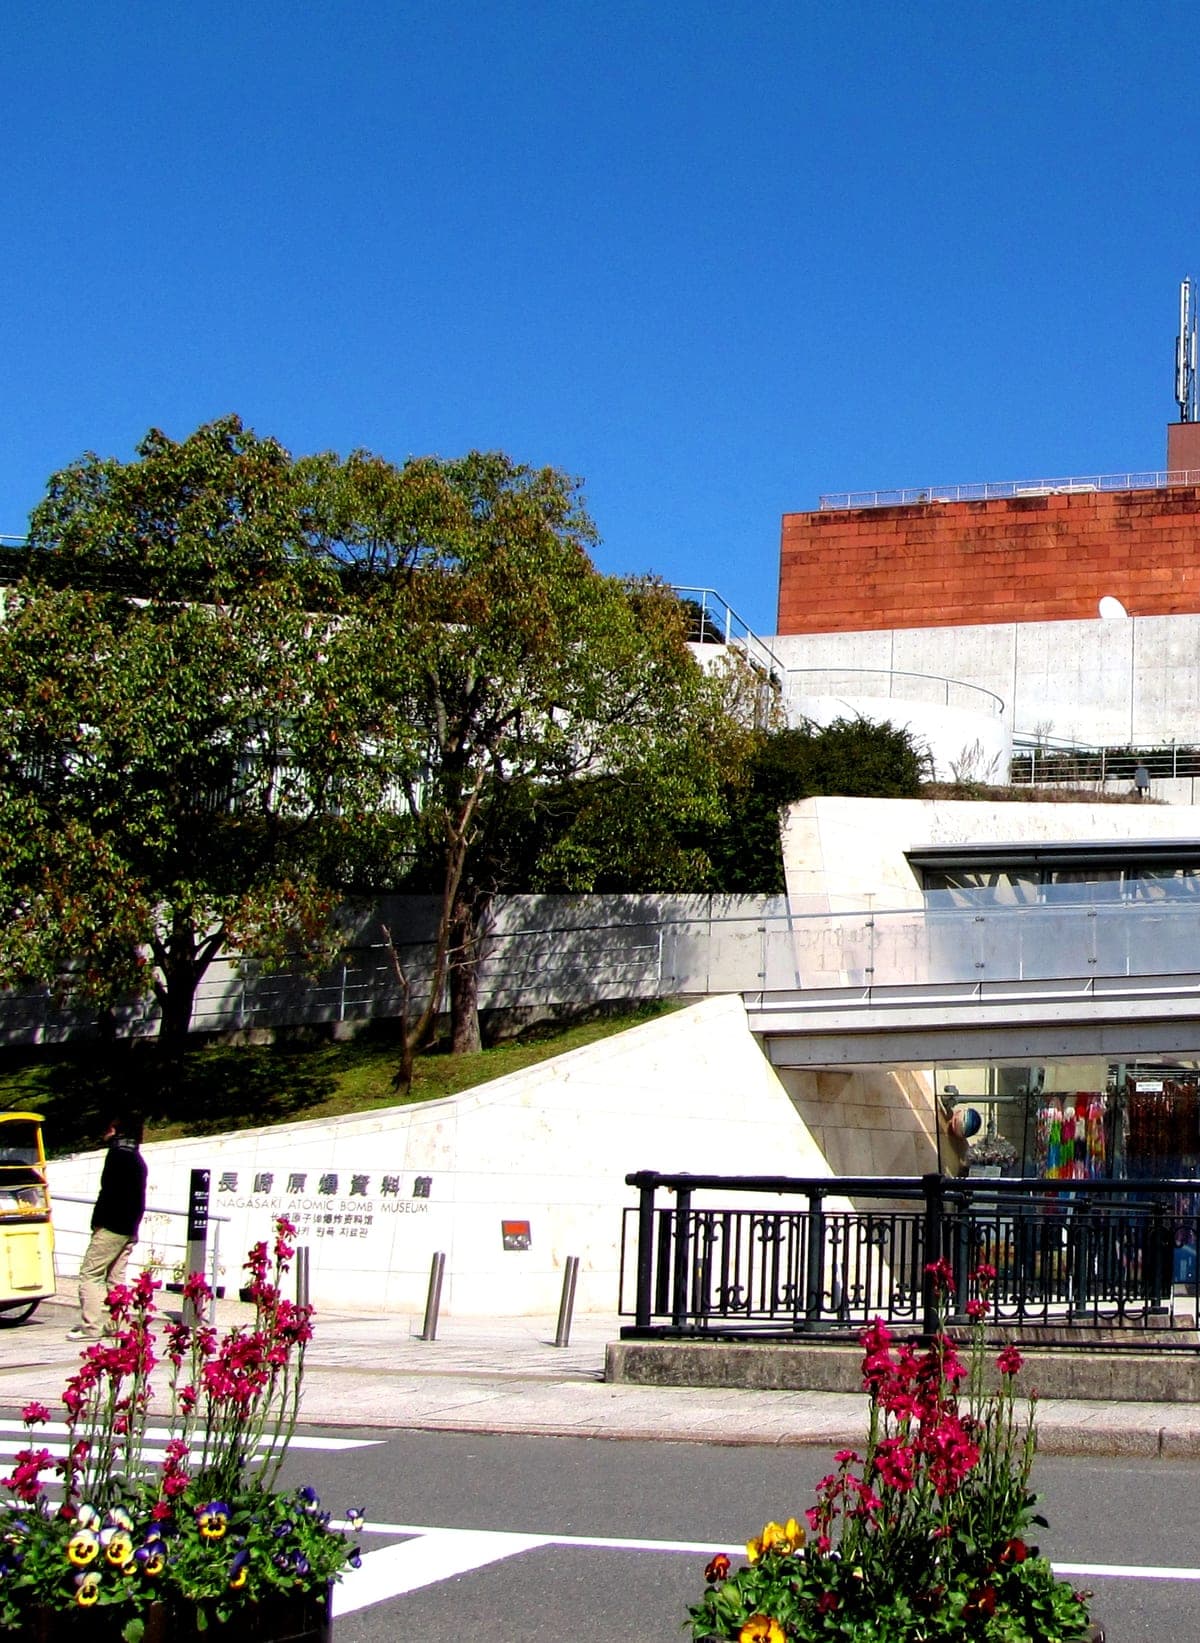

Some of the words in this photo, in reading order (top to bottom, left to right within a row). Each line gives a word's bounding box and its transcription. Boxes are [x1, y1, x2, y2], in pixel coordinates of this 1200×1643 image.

[218, 1172, 433, 1198] 長崎原爆資料館
[216, 1196, 282, 1209] NAGASAKI
[287, 1199, 334, 1211] ATOMIC
[340, 1200, 373, 1212] BOMB
[381, 1202, 429, 1214] MUSEUM
